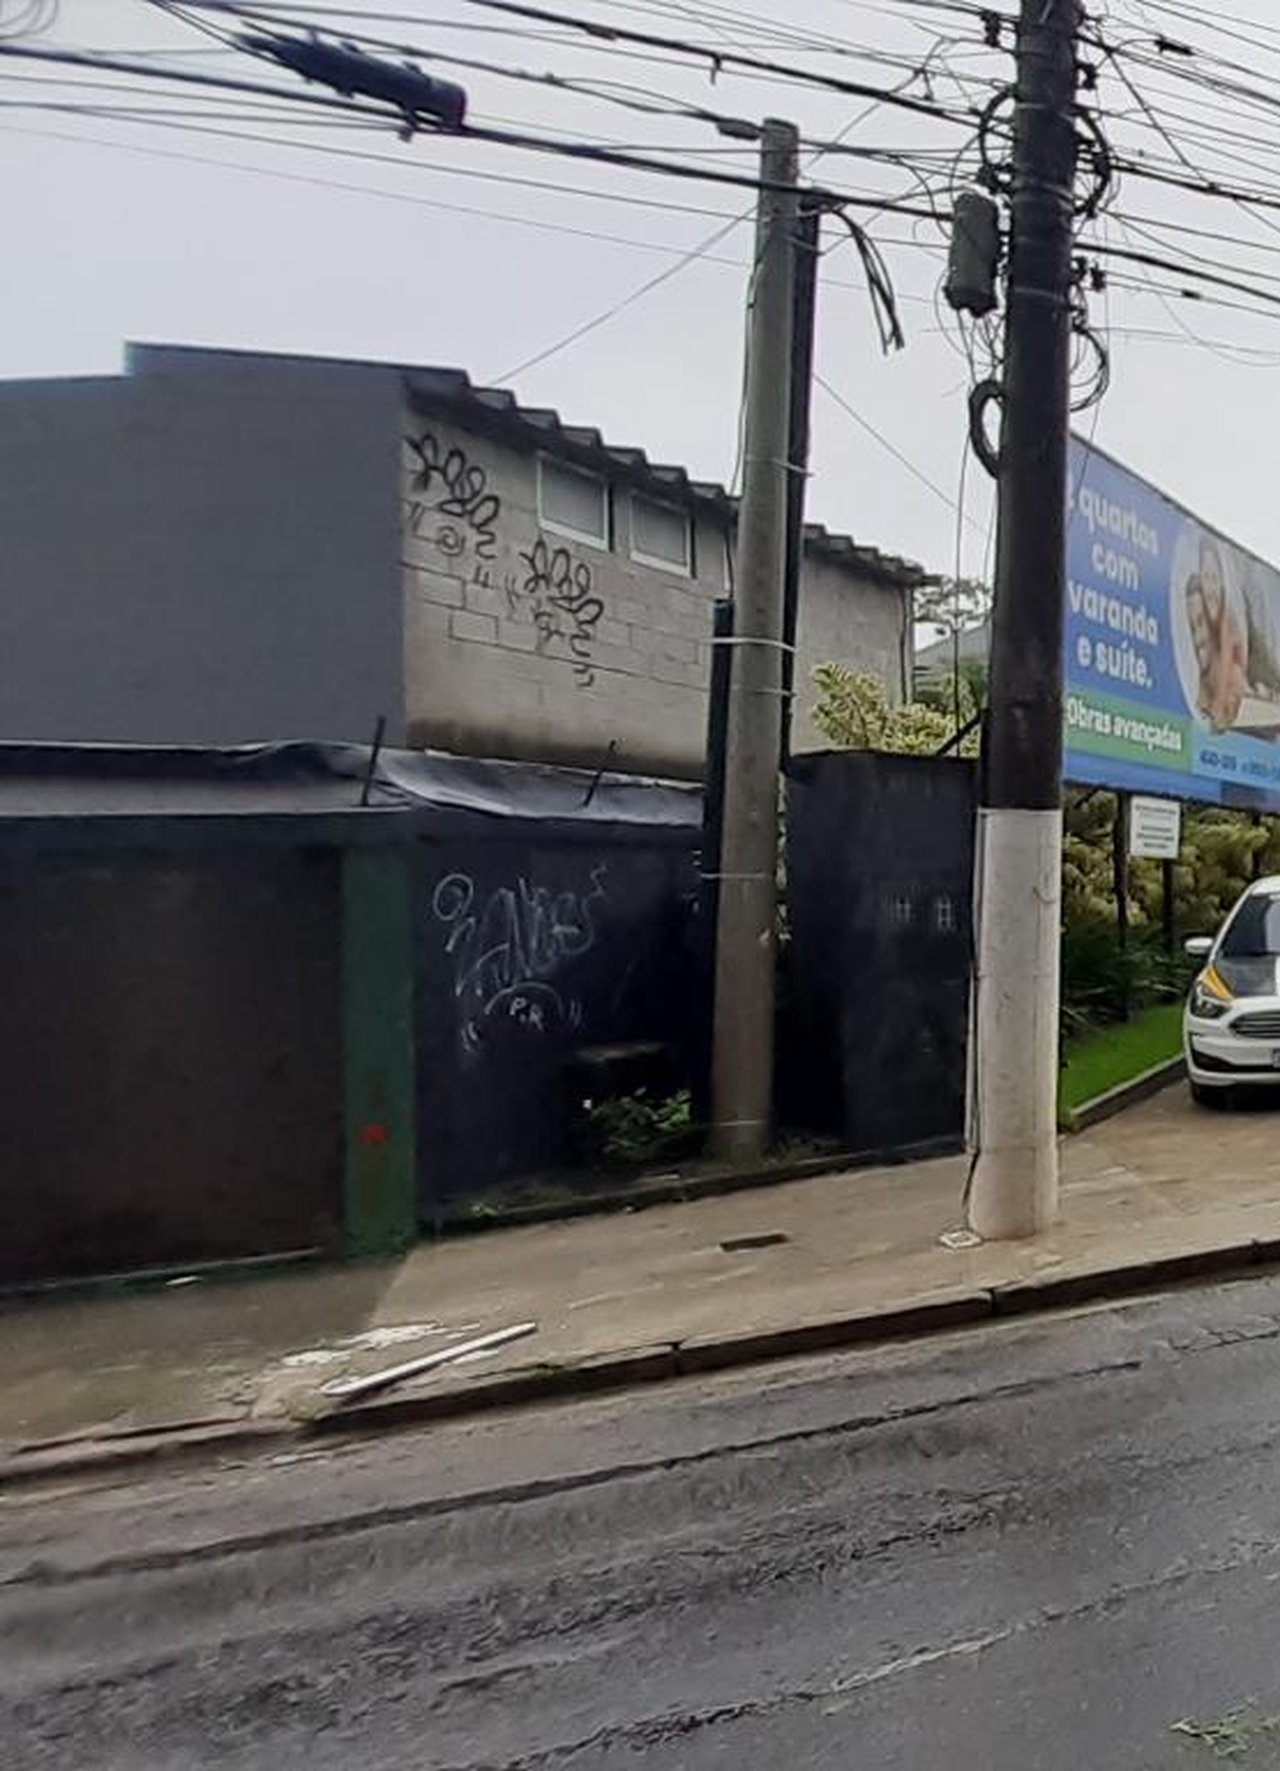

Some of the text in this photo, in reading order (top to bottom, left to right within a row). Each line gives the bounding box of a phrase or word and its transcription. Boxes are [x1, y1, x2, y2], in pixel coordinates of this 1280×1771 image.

[1078, 486, 1158, 555] quartos
[1092, 543, 1138, 590] com
[1068, 580, 1158, 645] varanda
[1077, 636, 1152, 689] e suíte.
[1068, 697, 1111, 734] Obras
